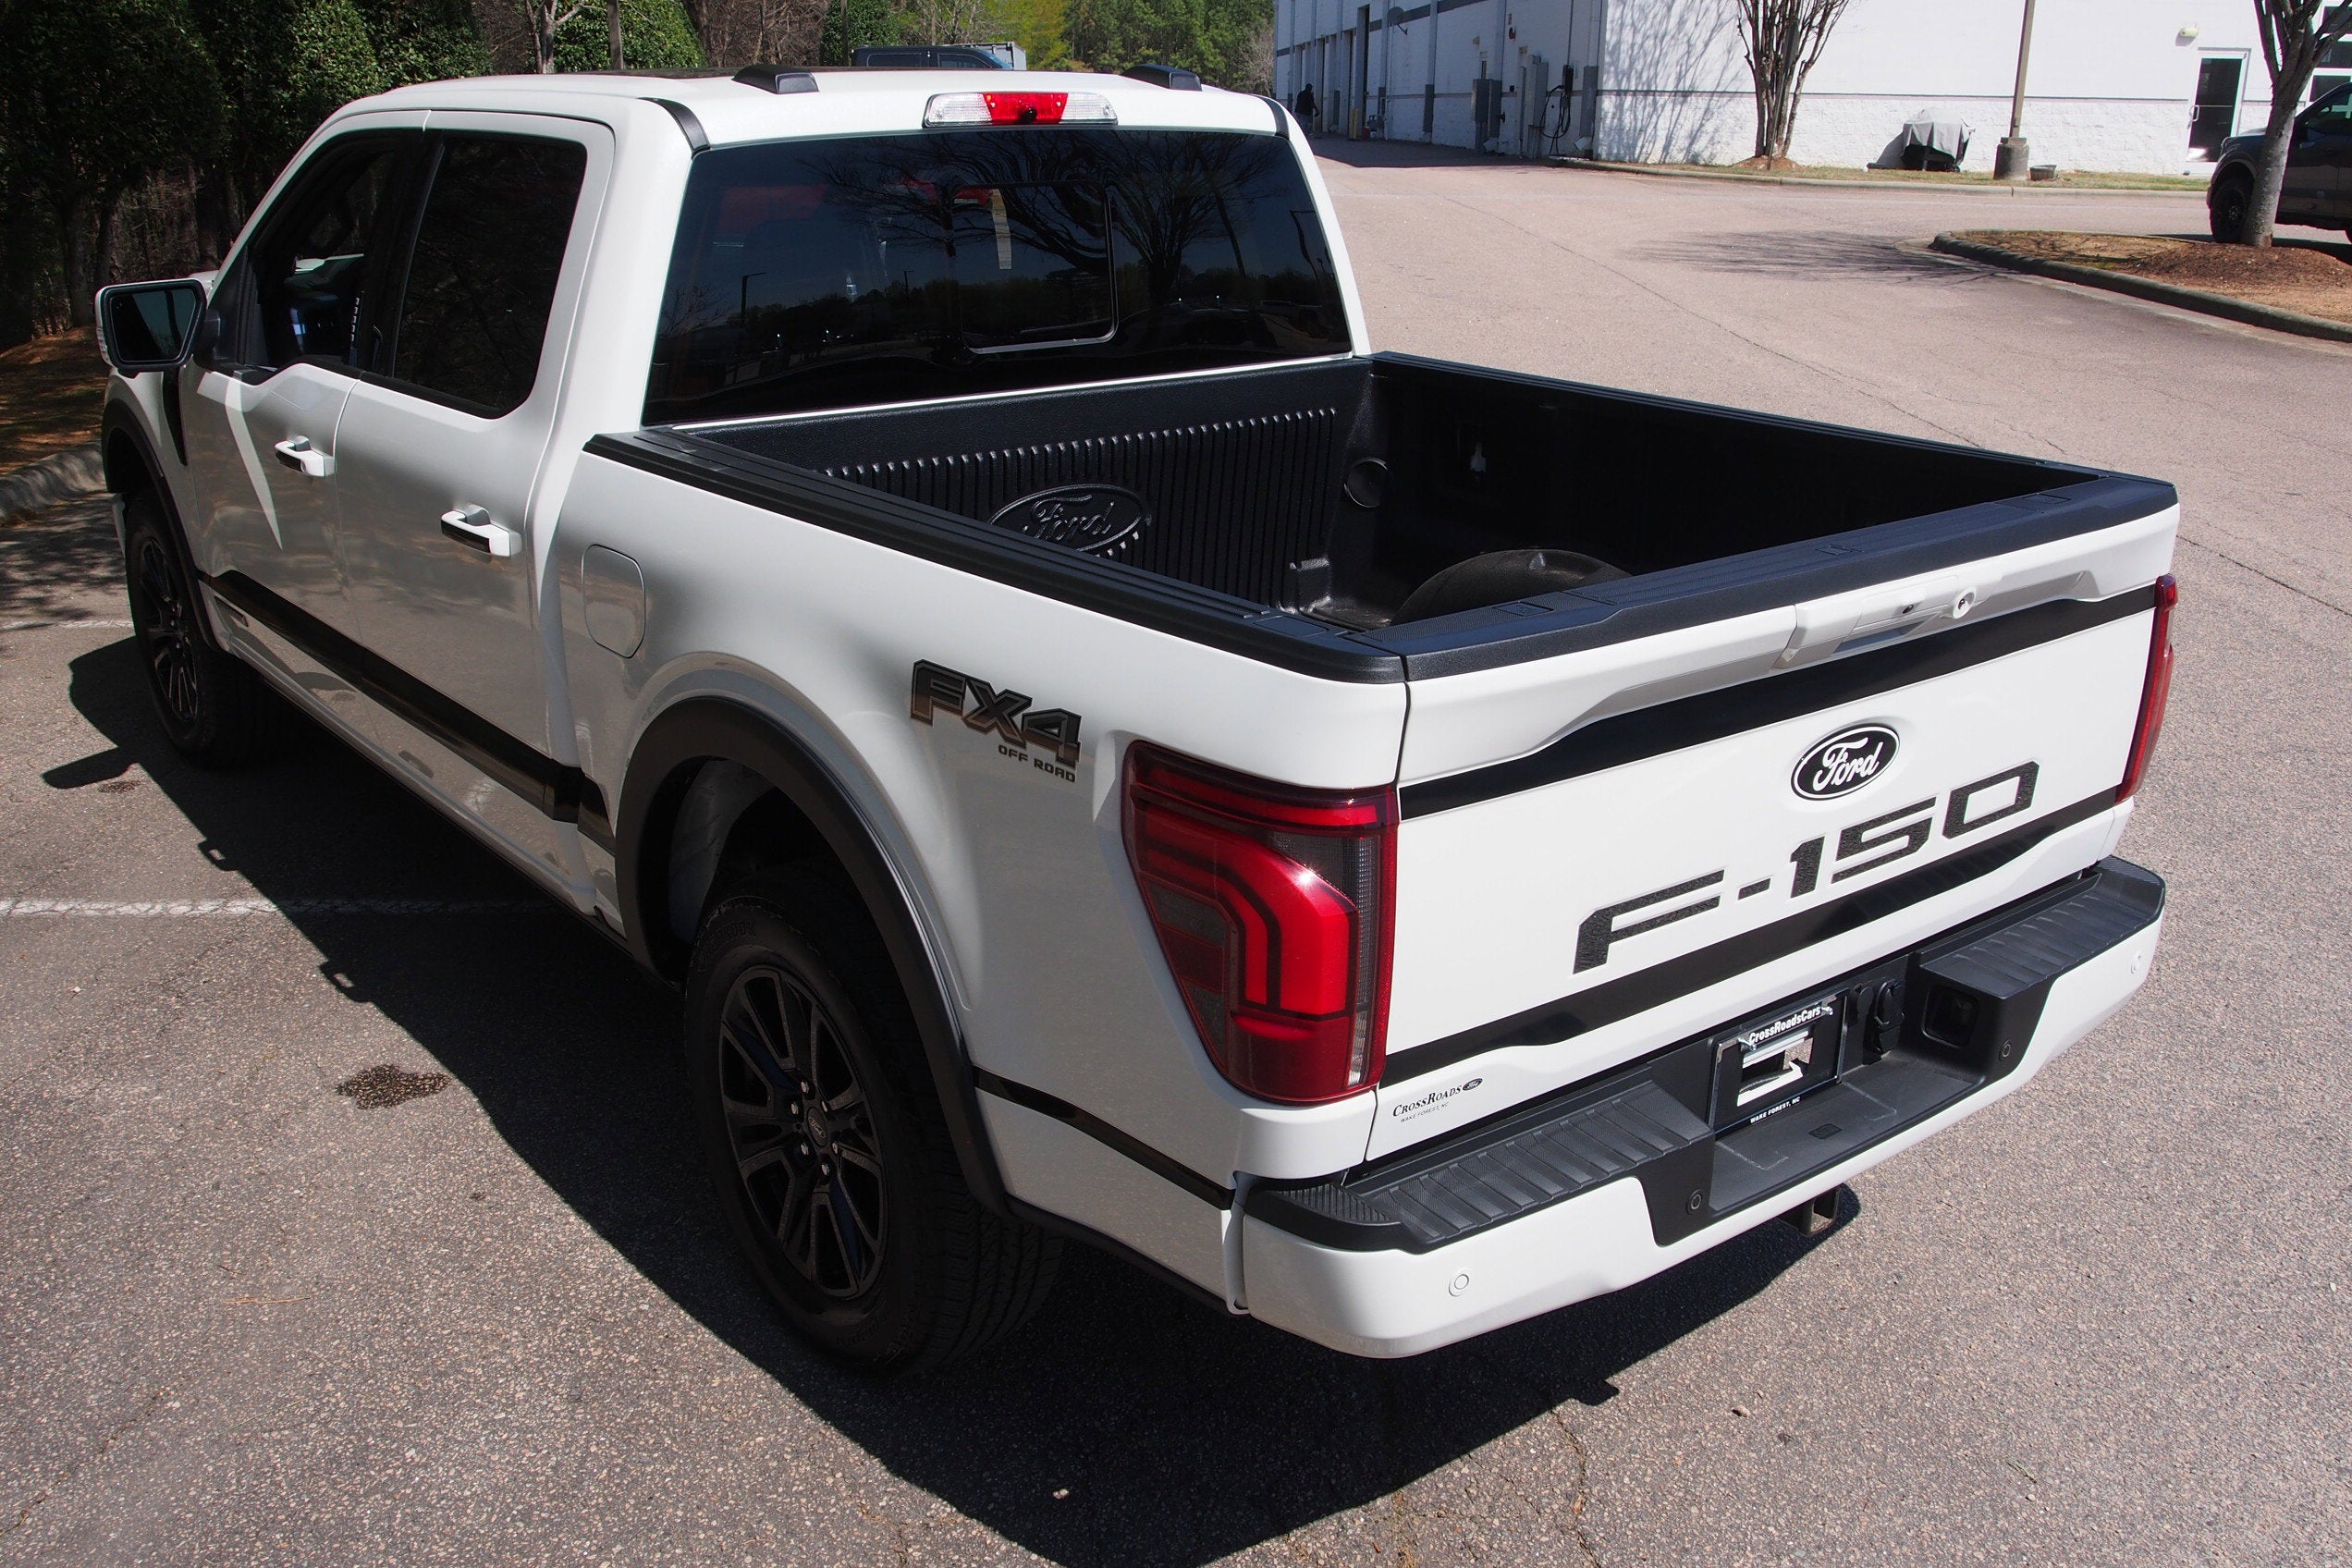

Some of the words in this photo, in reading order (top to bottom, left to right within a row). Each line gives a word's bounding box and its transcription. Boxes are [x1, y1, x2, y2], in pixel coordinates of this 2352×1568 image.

[1022, 494, 1115, 541] Ford
[911, 658, 1082, 770] FX4
[998, 743, 1028, 763] OFF
[1034, 757, 1076, 783] ROAD
[1812, 737, 1884, 792] Ford
[1573, 760, 2040, 975] F-150
[1748, 1006, 1821, 1045] CrossRoadsCars
[1400, 1113, 1415, 1123] WAKE
[1749, 1111, 1767, 1124] WAKE
[1768, 1100, 1792, 1116] FOREST,
[1792, 1096, 1801, 1106] NC
